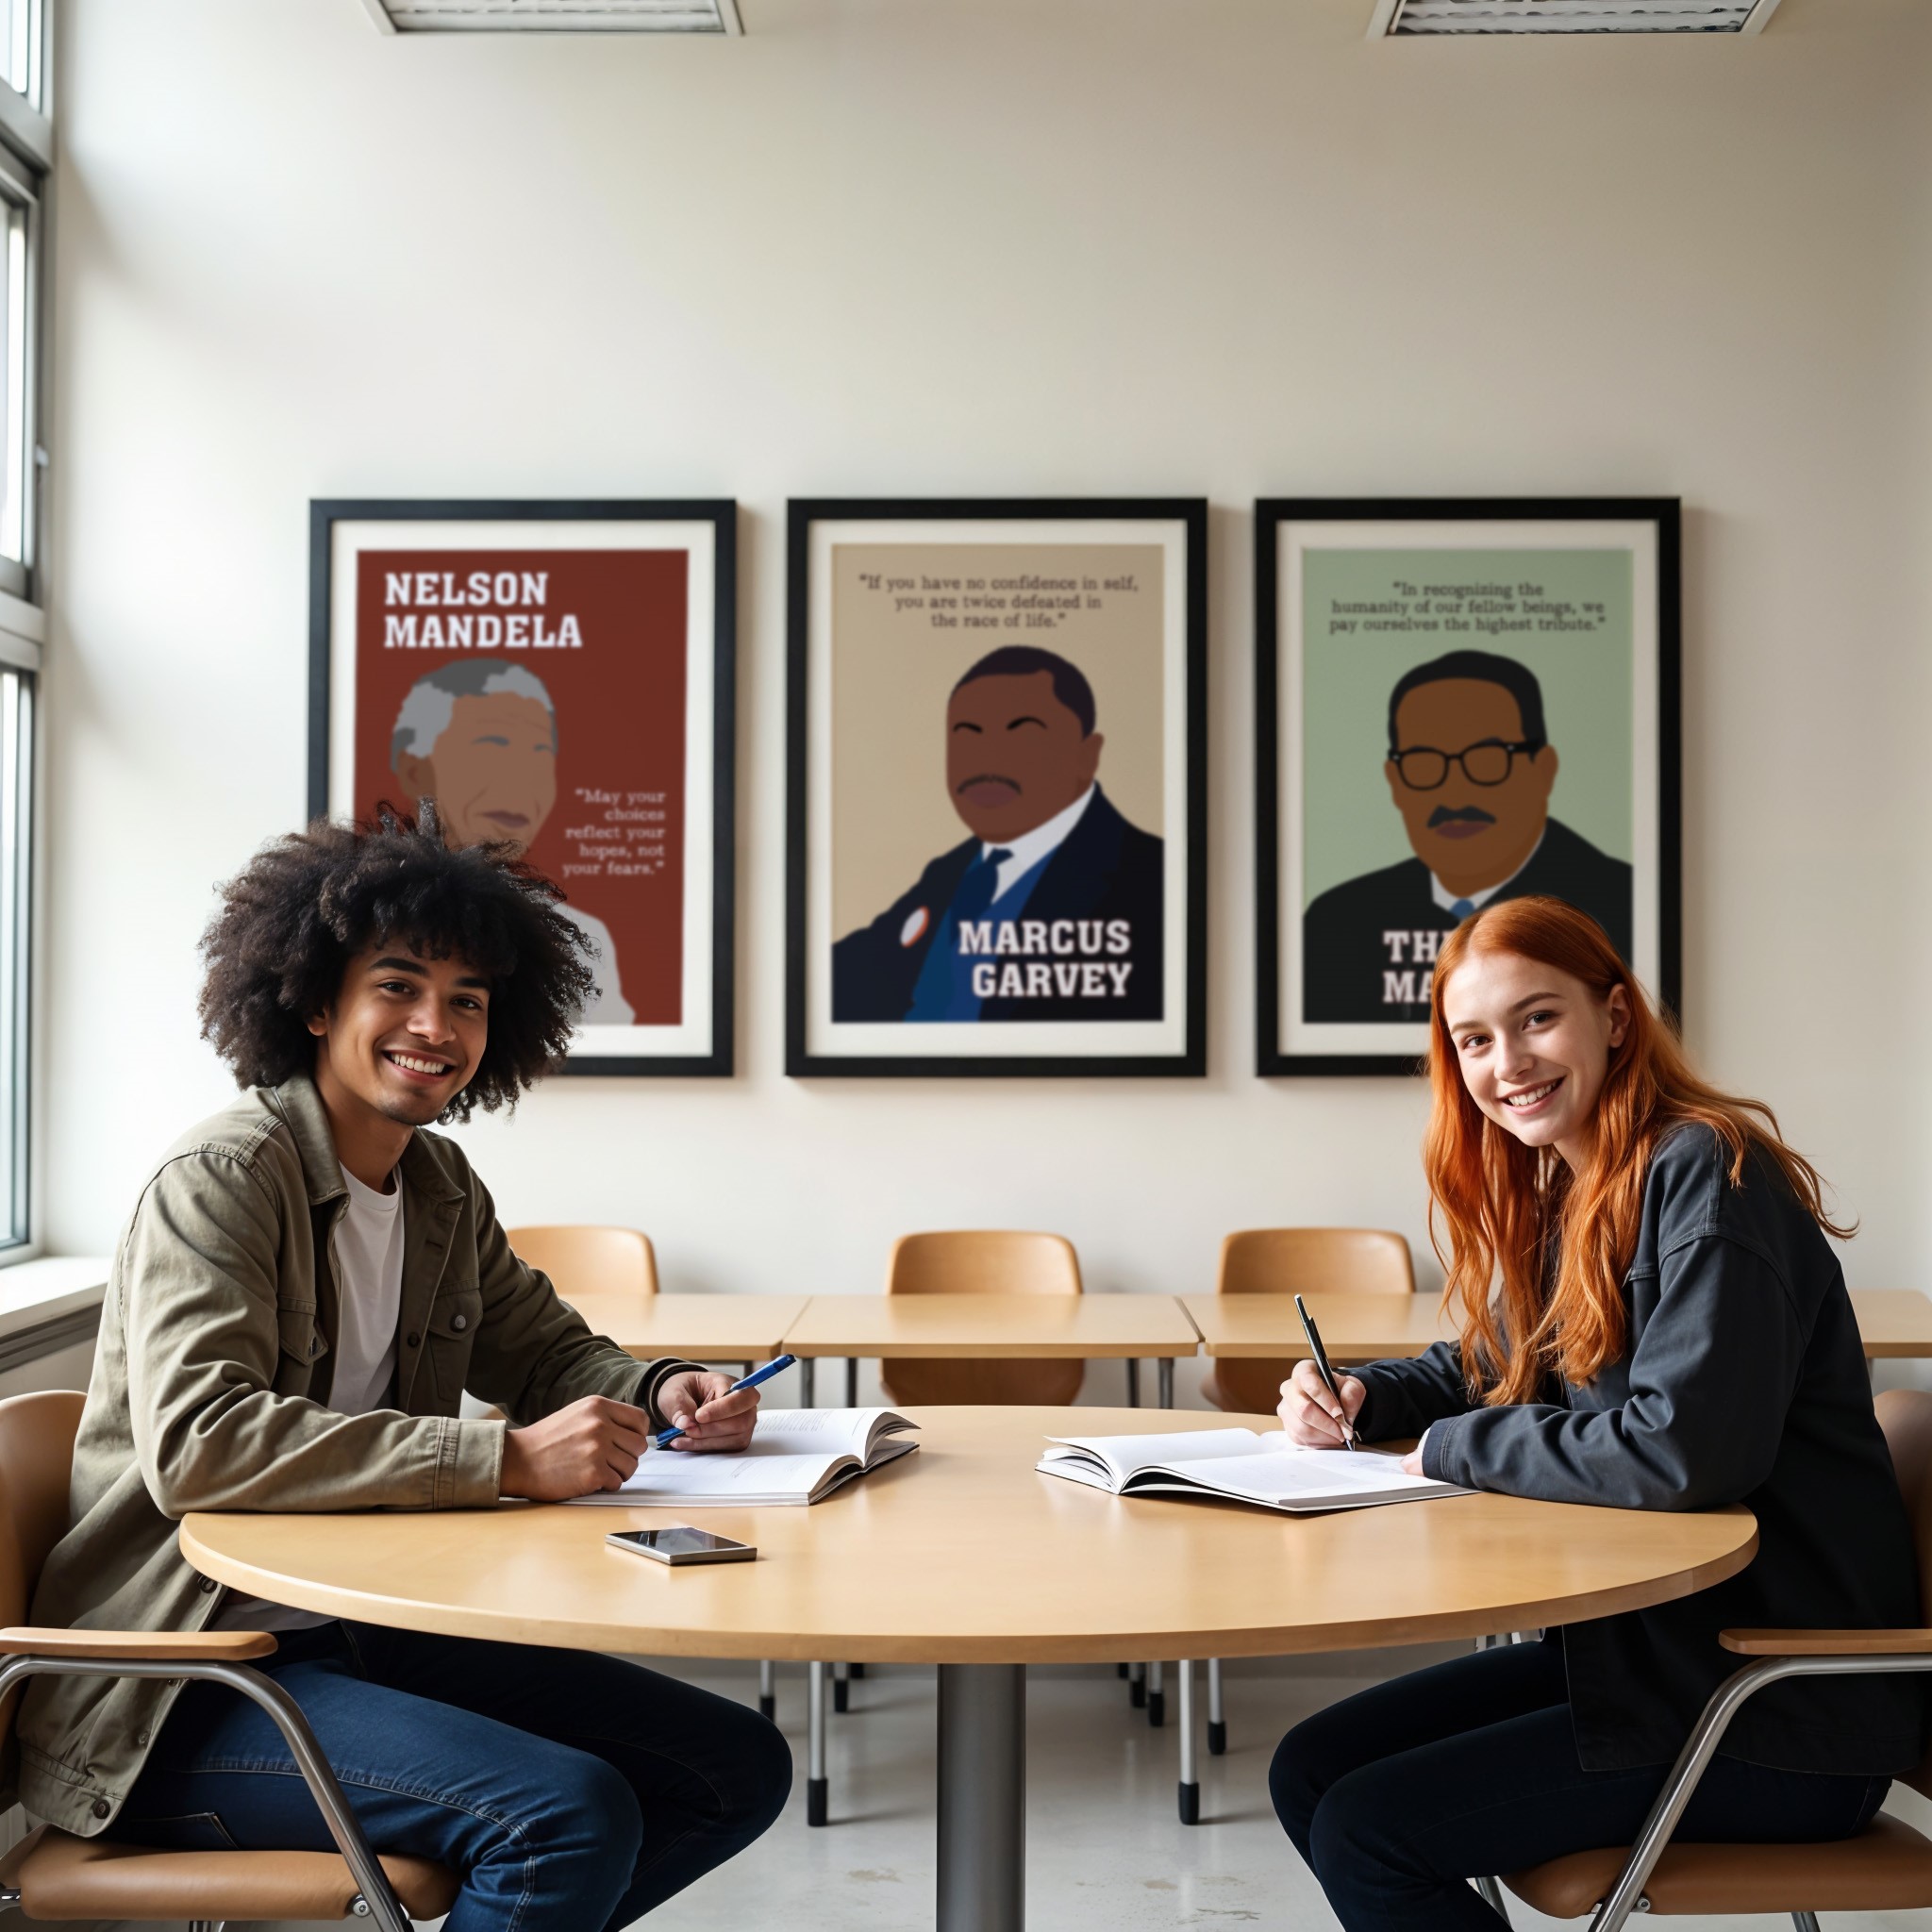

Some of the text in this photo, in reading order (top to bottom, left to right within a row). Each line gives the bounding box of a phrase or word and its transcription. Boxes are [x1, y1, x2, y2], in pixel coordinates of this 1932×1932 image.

[384, 572, 549, 607] NELSON
[887, 579, 915, 593] you
[922, 575, 961, 591] have
[966, 578, 986, 591] no
[991, 575, 1077, 591] confidence
[1082, 576, 1098, 591] in
[1103, 575, 1139, 592] self,
[1423, 582, 1513, 599] recognizing
[1517, 582, 1545, 597] the
[895, 593, 1102, 611] you are twice defeated in
[1331, 600, 1606, 617] humanity of our fellow beings, we
[931, 612, 958, 628] the
[963, 615, 999, 628] race
[1003, 612, 1021, 628] of
[1329, 621, 1357, 636] pay
[1363, 618, 1439, 632] ourselves
[1444, 618, 1470, 632] the
[1475, 618, 1532, 635] highest
[383, 614, 583, 649] MANDELA
[626, 791, 666, 807] your
[604, 807, 666, 822] choices
[565, 824, 666, 842] reflect your
[578, 842, 665, 861] hopes, not
[562, 862, 603, 878] your
[958, 920, 1131, 955] MARCUS
[972, 962, 1132, 998] GARVEY
